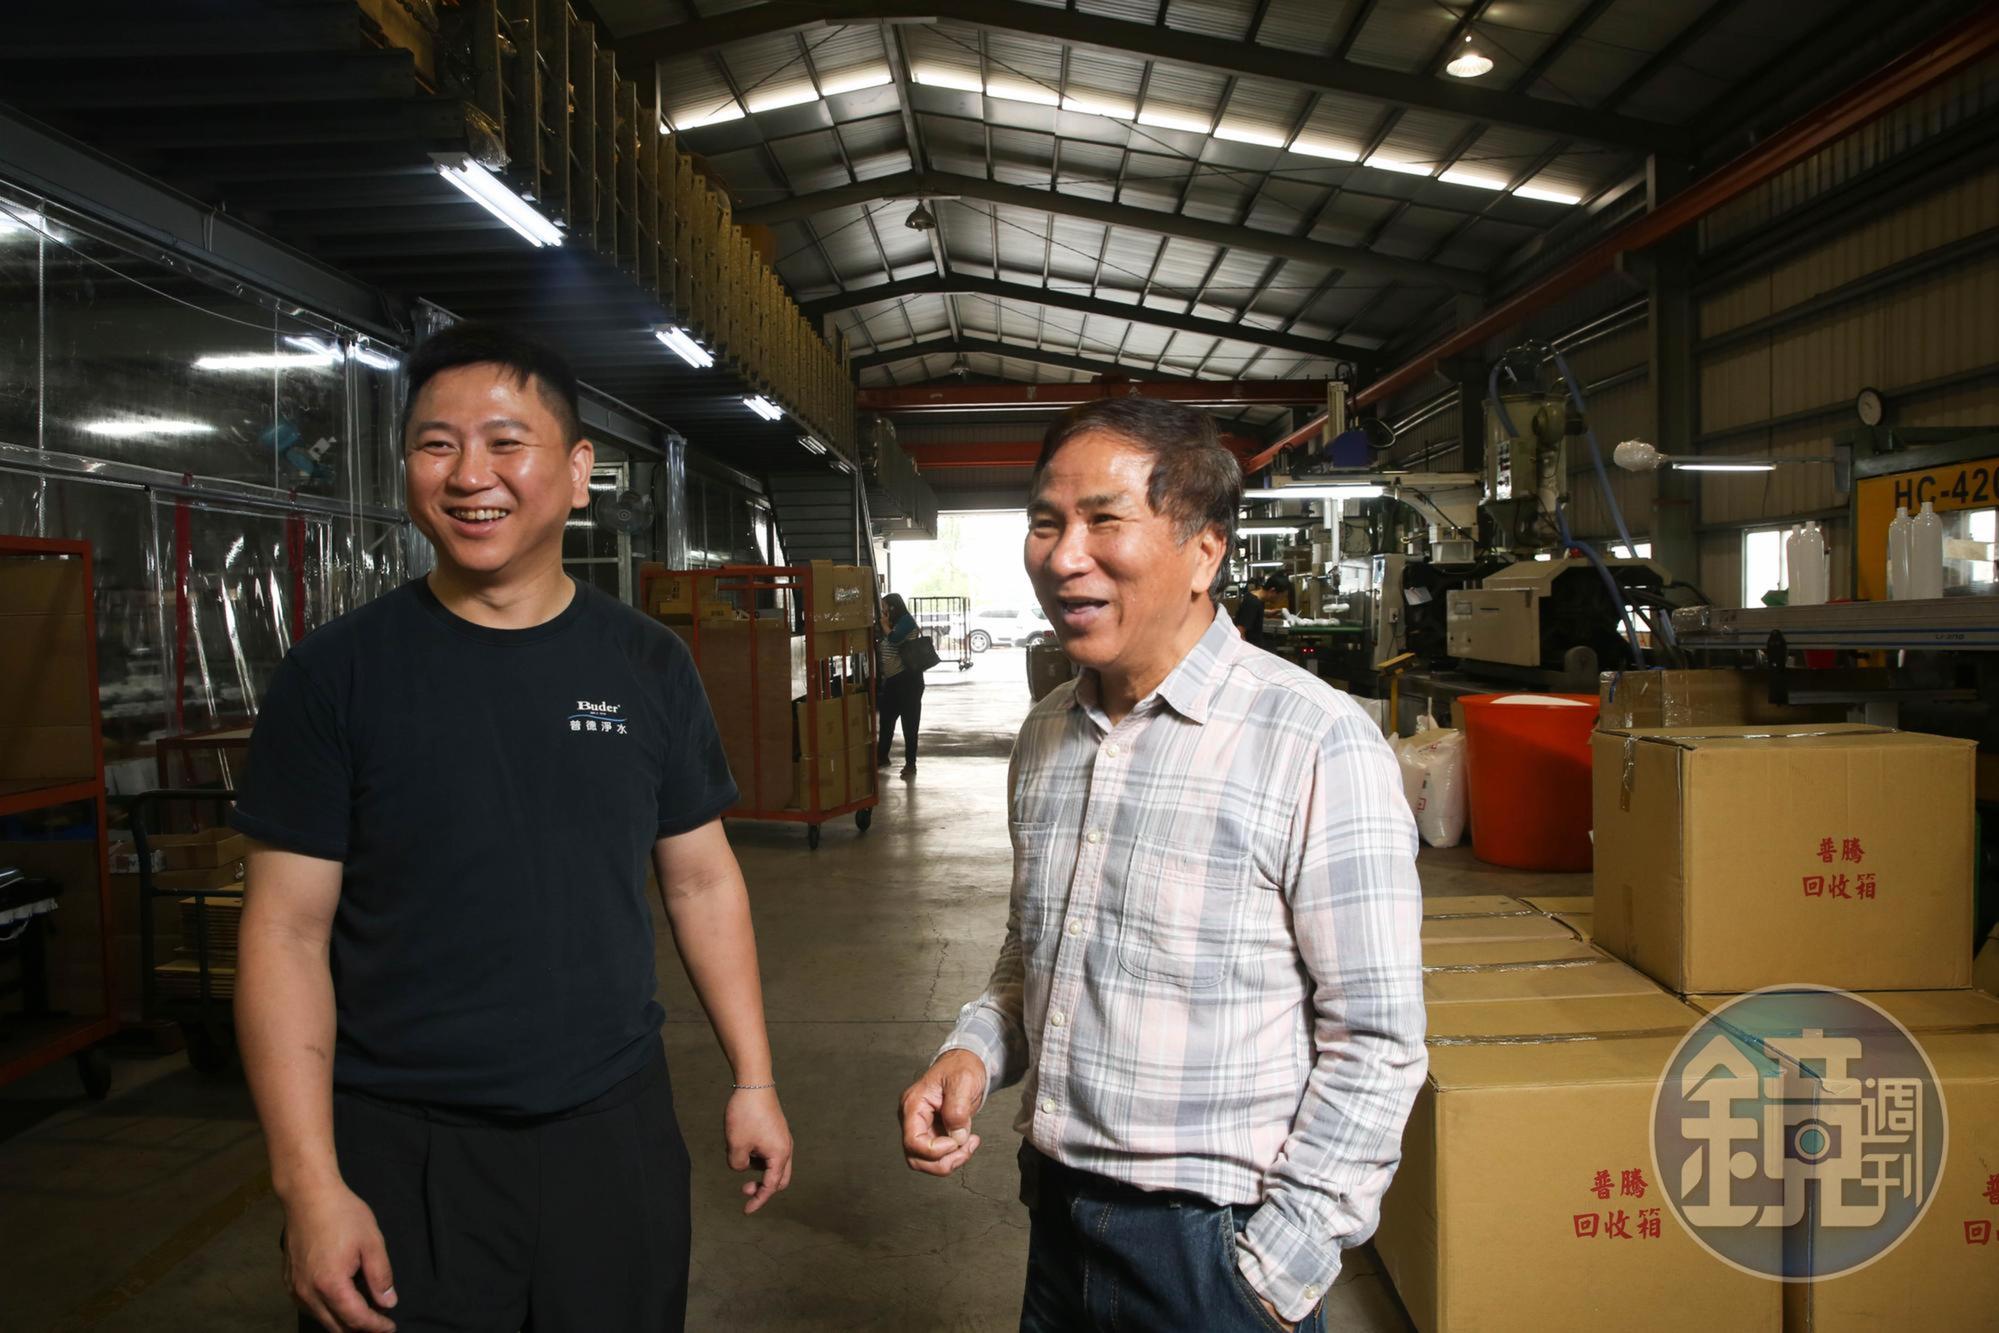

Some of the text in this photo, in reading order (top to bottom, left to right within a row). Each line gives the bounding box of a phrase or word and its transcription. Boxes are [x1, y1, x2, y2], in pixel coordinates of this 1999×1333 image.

[576, 700, 618, 713] Buder
[1816, 836, 1865, 864] 普騰
[1802, 873, 1876, 900] 回收箱
[1590, 1167, 1648, 1200] 普騰
[1573, 1207, 1661, 1240] 回收箱
[1964, 1219, 1999, 1246] 回
